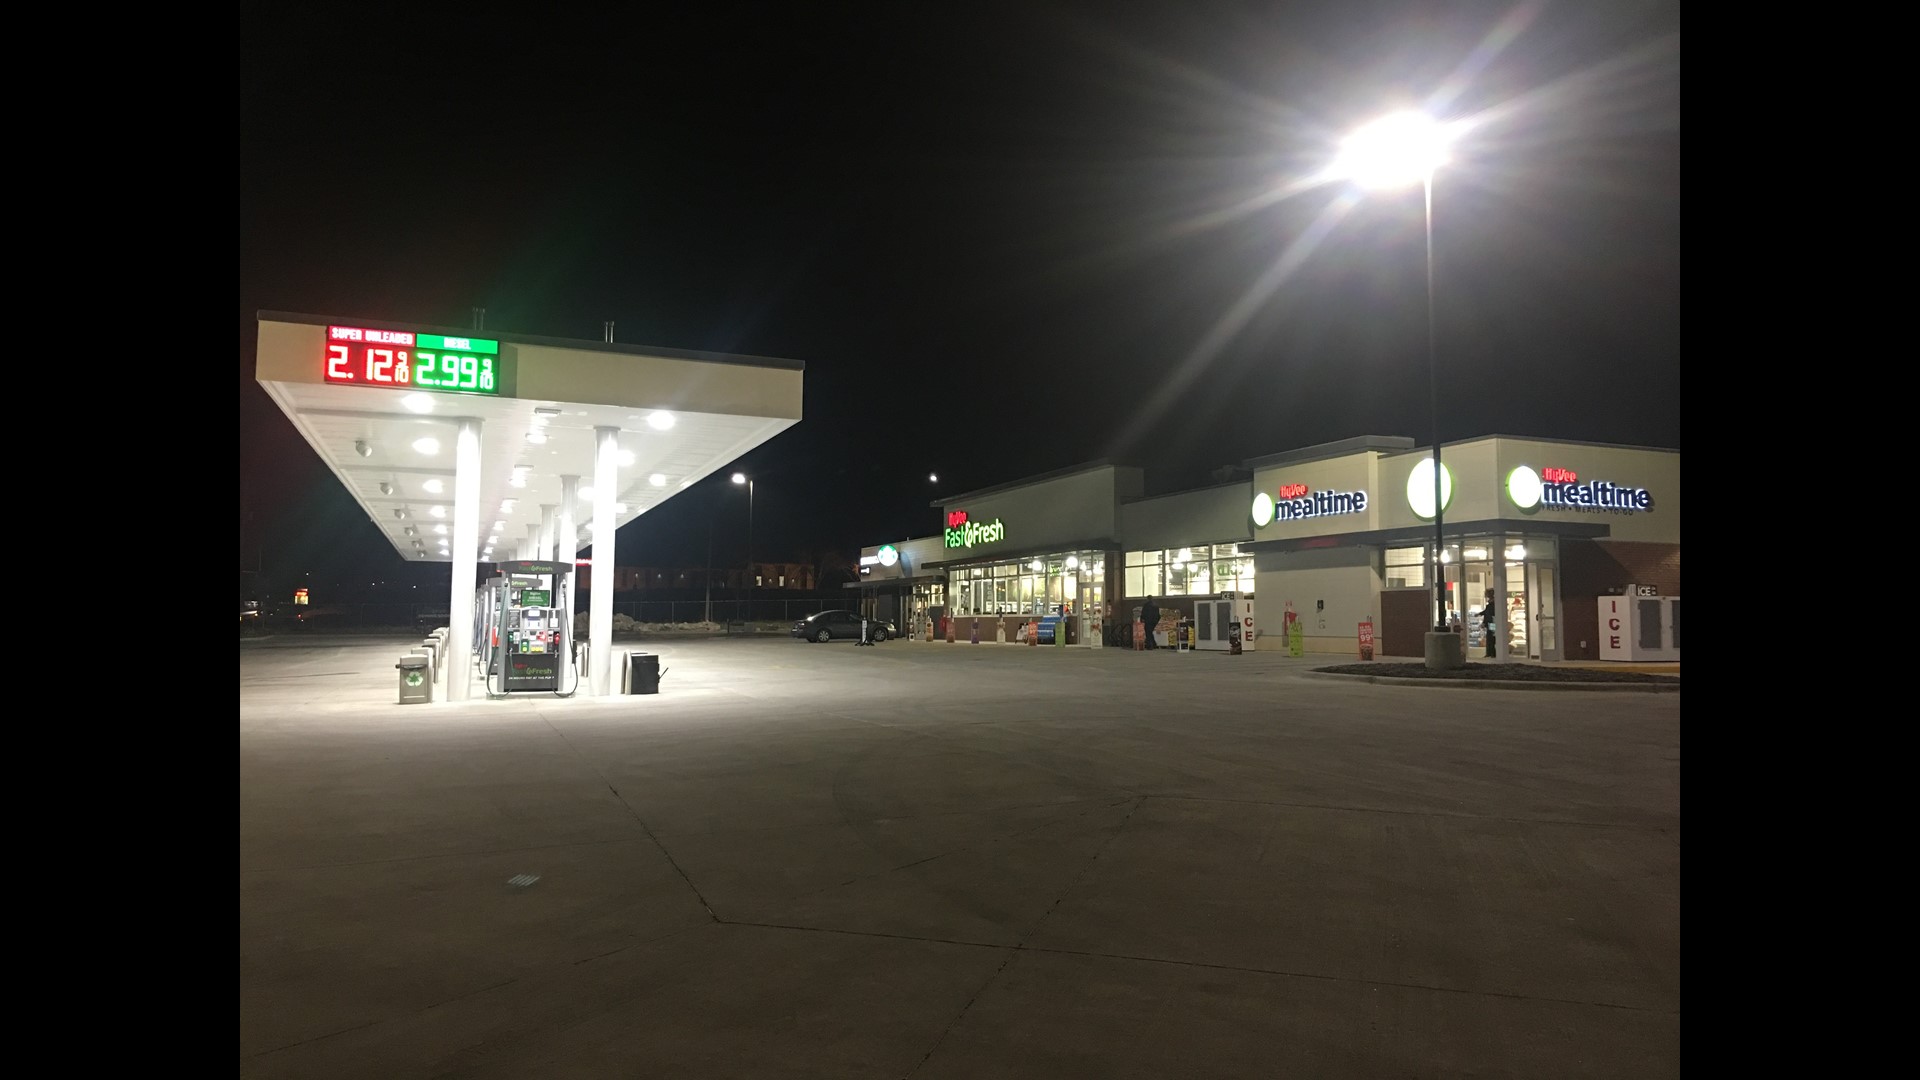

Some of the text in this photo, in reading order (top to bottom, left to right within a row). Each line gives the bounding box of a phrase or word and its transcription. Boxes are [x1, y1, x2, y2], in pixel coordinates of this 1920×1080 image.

[332, 327, 413, 345] SUPER UNLEADED
[416, 353, 478, 388] 2.99
[1275, 489, 1368, 520] mealtime
[1541, 480, 1651, 509] mealtime
[1575, 506, 1600, 514] MEALS
[1222, 592, 1230, 600] ICE
[1638, 586, 1651, 596] ICE
[1244, 603, 1253, 642] ICE
[1608, 600, 1621, 649] ICE
